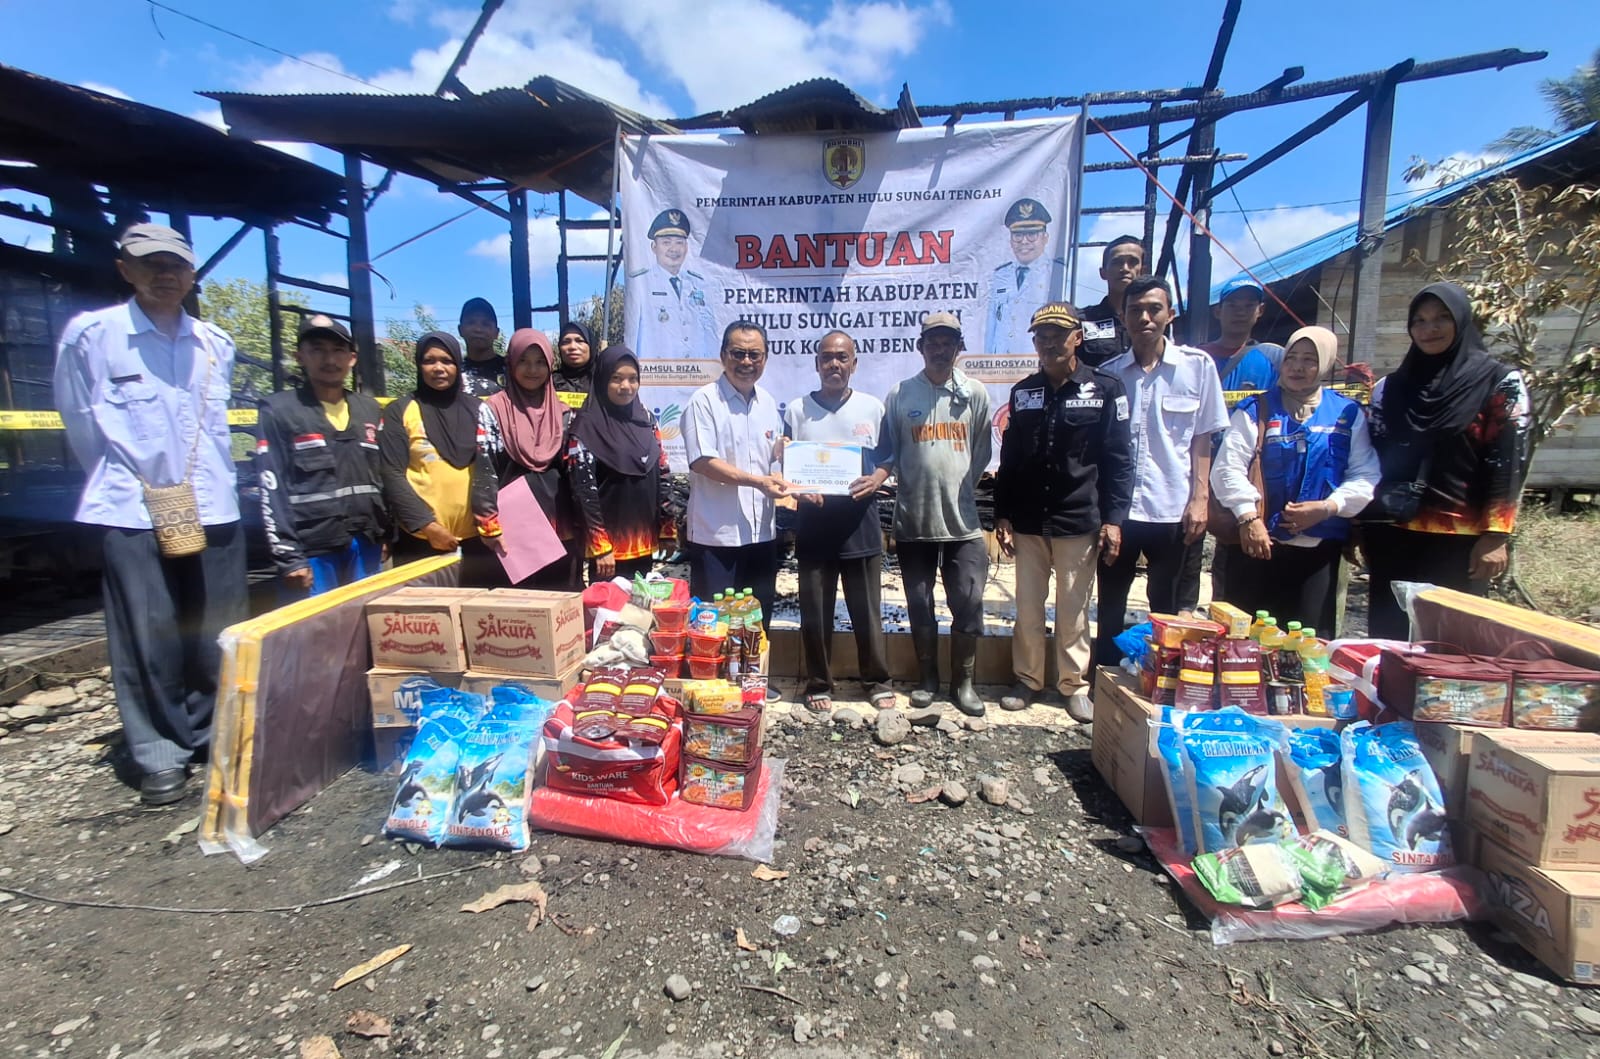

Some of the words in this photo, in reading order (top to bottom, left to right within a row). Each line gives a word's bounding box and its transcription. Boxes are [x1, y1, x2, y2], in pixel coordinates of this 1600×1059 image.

[696, 196, 776, 208] PEMERINTAH
[779, 194, 854, 206] KABUPATEN
[858, 192, 892, 203] HULU
[896, 190, 945, 201] SUNGAI
[949, 188, 1001, 200] TENGAH
[735, 230, 954, 270] BANTUAN
[724, 287, 850, 304] PEMERINTAH
[856, 283, 978, 302] KABUPATEN
[798, 312, 873, 328] SUNGAI
[965, 360, 993, 369] GUSTI
[995, 360, 1036, 368] ROSYADI
[572, 772, 594, 781] KIDS
[597, 771, 629, 780] WARE
